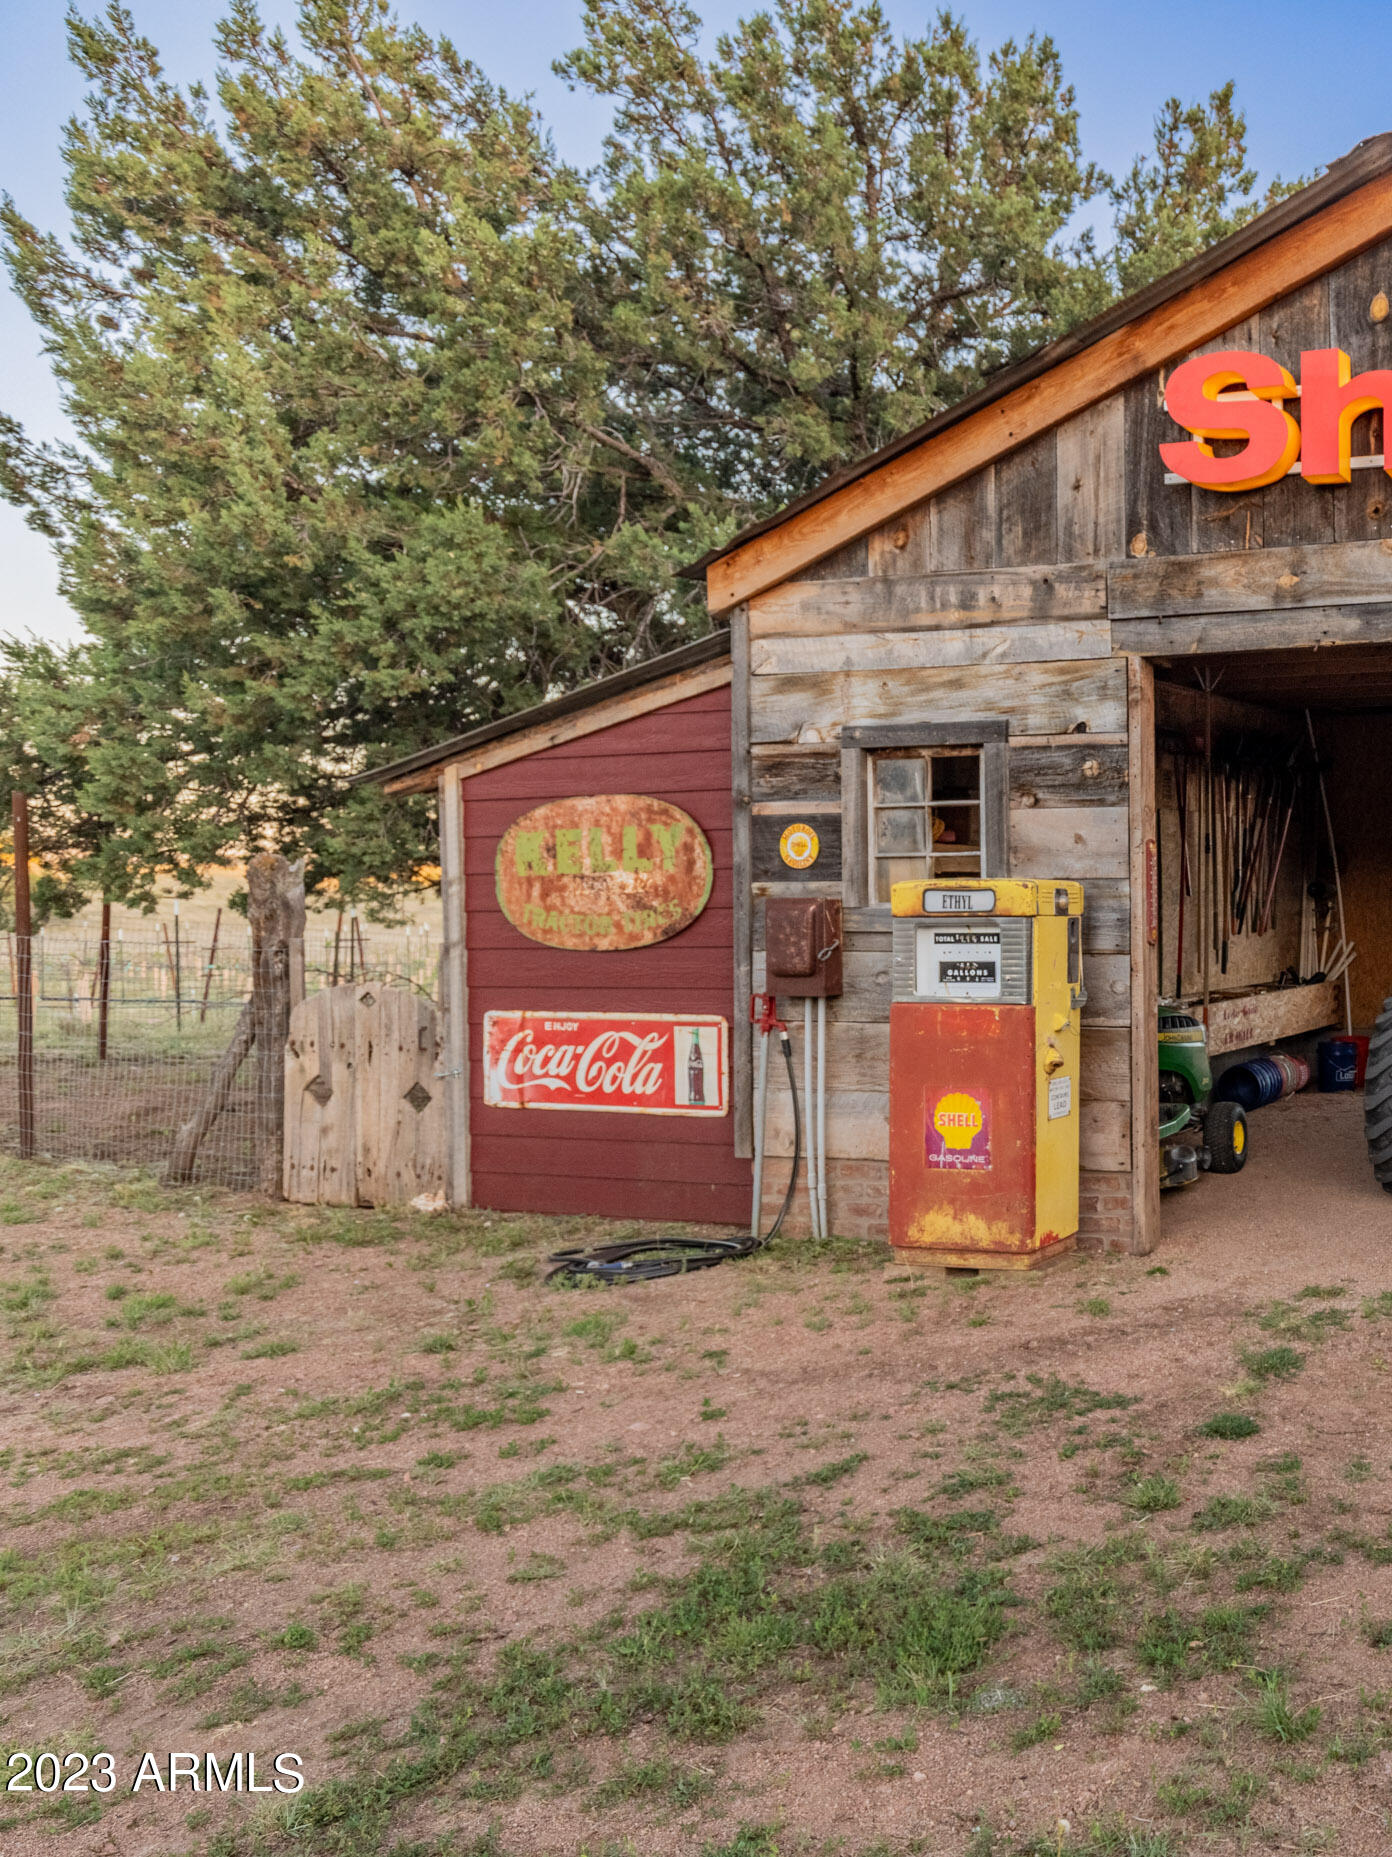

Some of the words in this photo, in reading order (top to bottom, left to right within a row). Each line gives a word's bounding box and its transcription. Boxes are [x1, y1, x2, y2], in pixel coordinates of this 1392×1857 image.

[515, 822, 686, 877] KELLY
[942, 894, 974, 910] ETHYL
[935, 935, 955, 943] TOTAL
[979, 935, 998, 943] SALE
[946, 969, 989, 977] GALLONS
[543, 1021, 580, 1032] ENJOY
[497, 1029, 670, 1096] Coca-Cola
[937, 1111, 979, 1128] SHELL
[928, 1153, 987, 1164] GASOLINE
